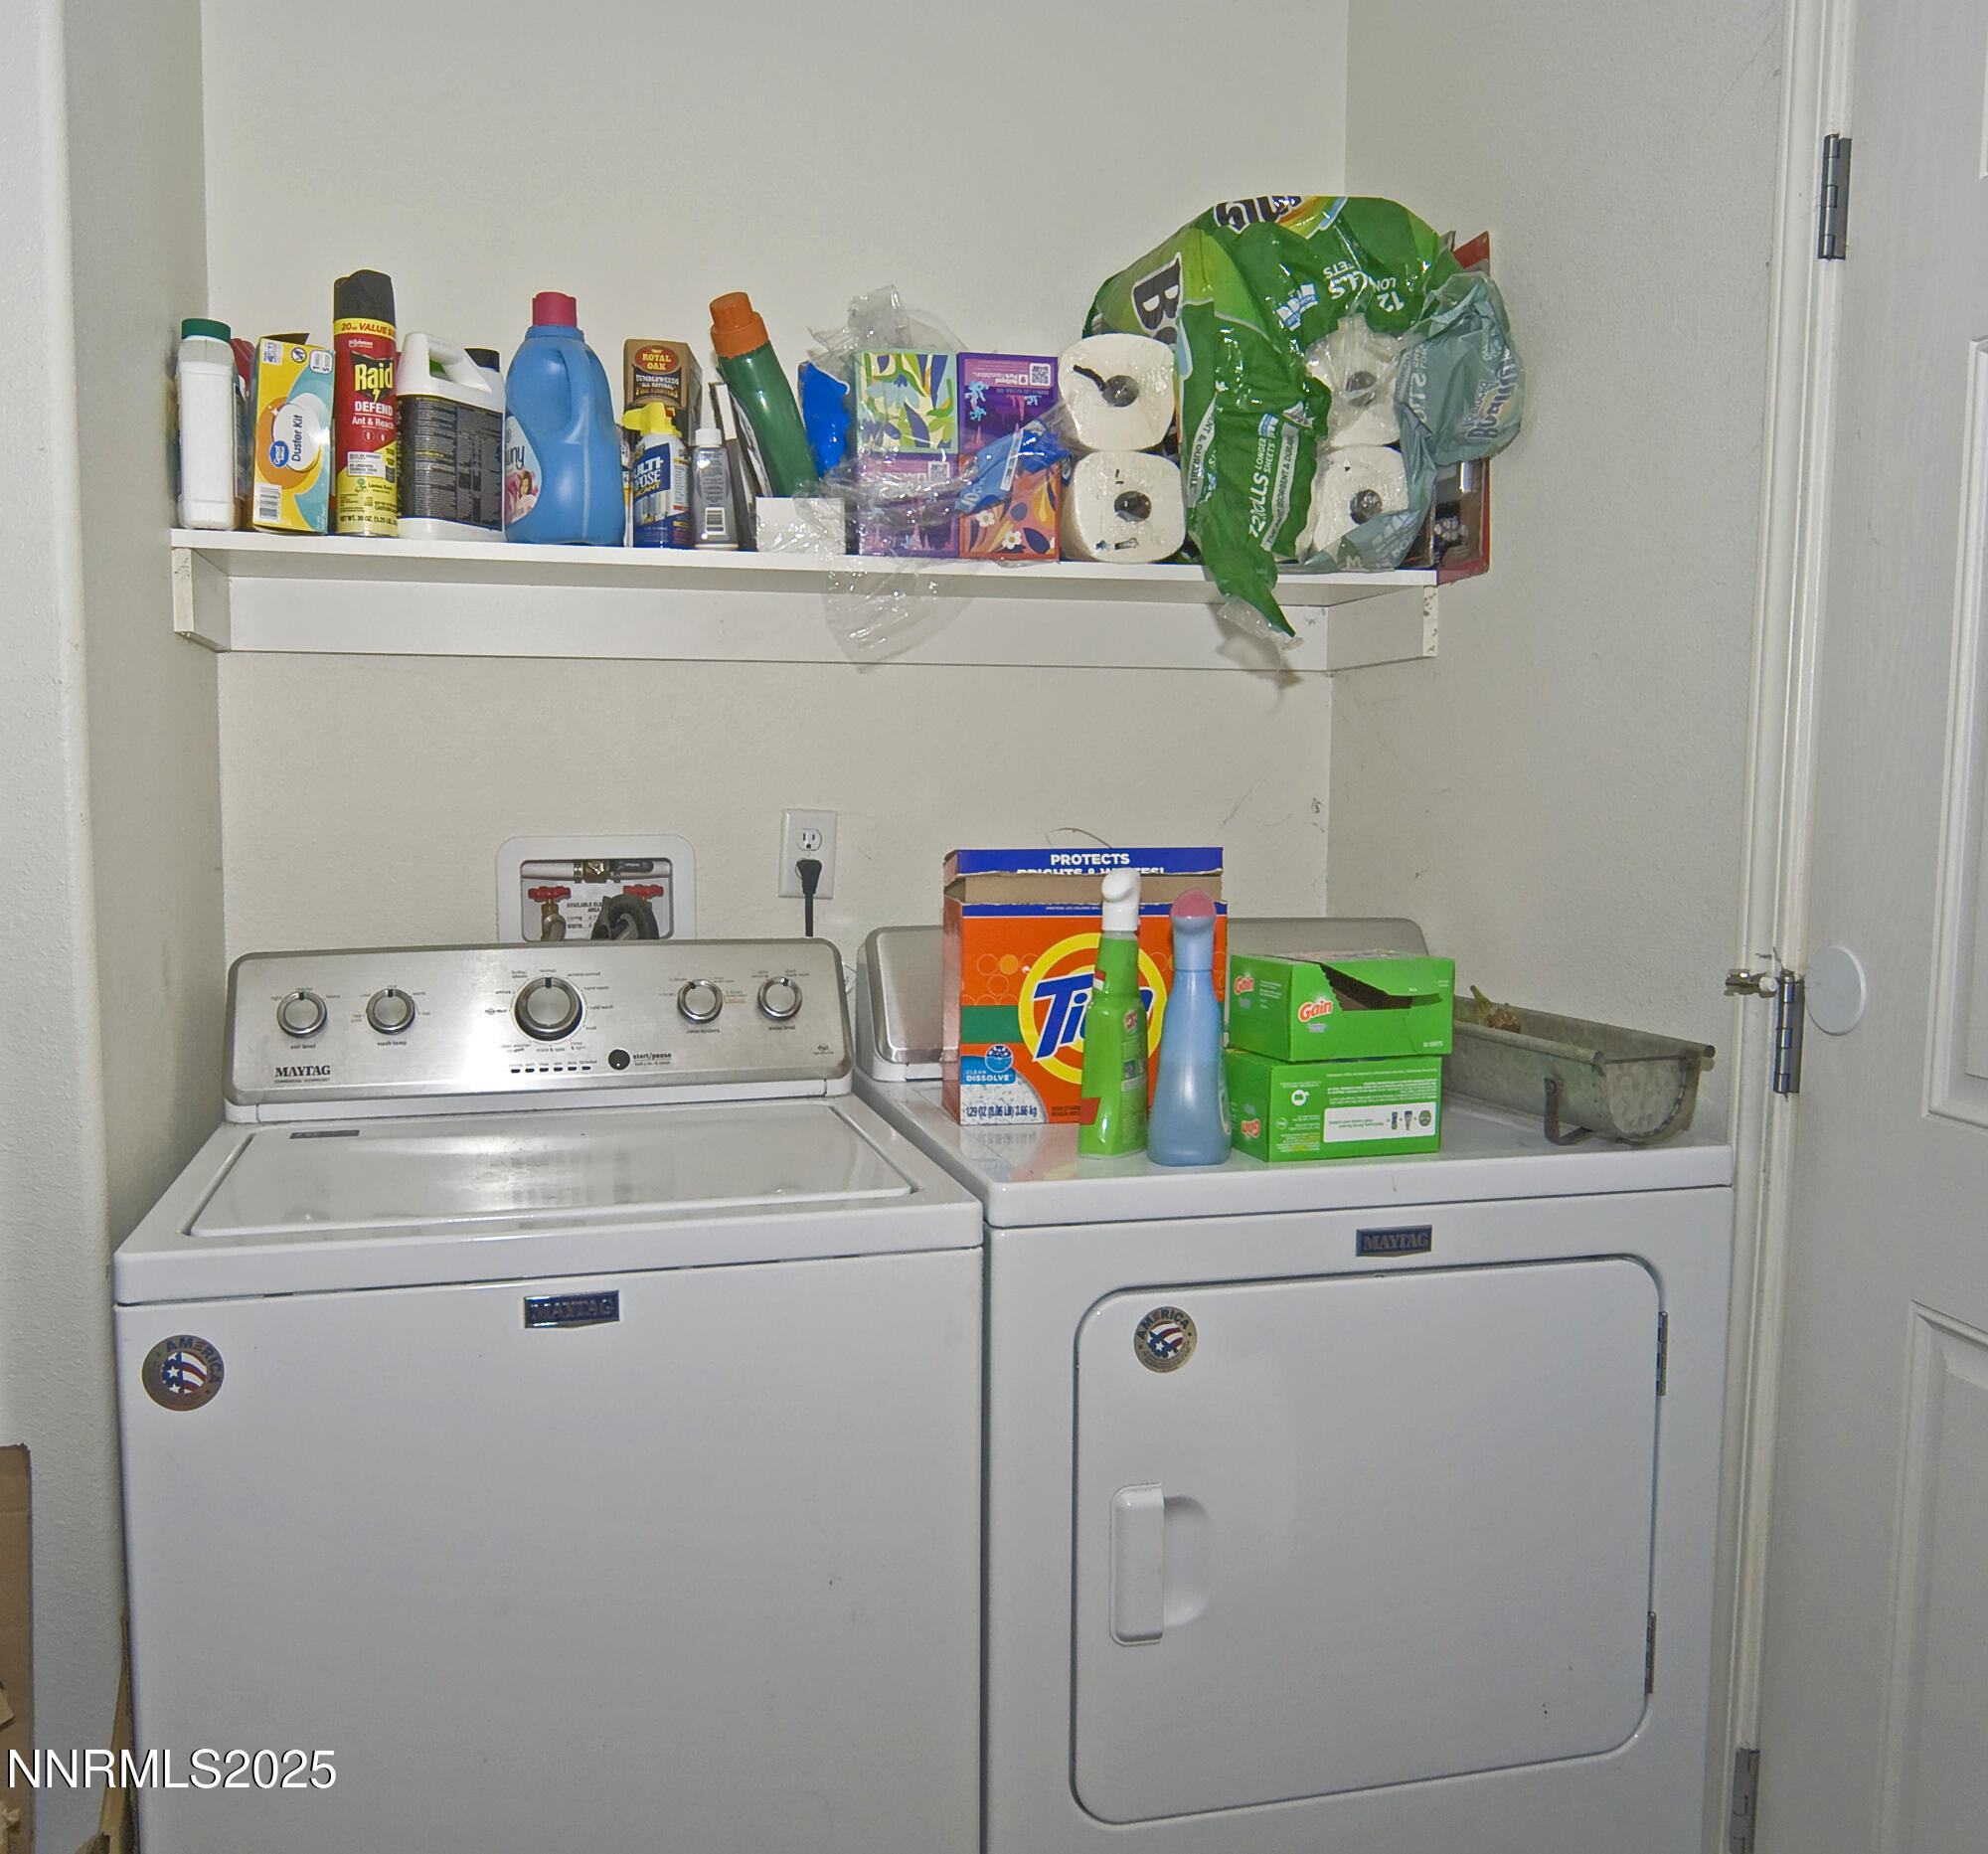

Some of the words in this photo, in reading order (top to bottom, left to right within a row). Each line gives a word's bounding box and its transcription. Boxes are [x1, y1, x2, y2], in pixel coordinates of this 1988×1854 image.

[1377, 291, 1405, 312] 12
[341, 322, 352, 331] 20
[359, 322, 388, 334] VALUE
[355, 362, 394, 392] Raid
[354, 401, 394, 416] DEFEND
[292, 415, 303, 427] Kit
[352, 417, 366, 425] Ant
[376, 419, 395, 429] Roach
[292, 427, 303, 461] Duster
[1256, 437, 1267, 470] LONGER
[634, 456, 664, 479] ULTI-
[1263, 441, 1275, 473] SHEETS
[1050, 853, 1130, 866] PROTECTS
[1234, 976, 1255, 994] Gain
[1032, 971, 1155, 1062] Ti
[1298, 999, 1333, 1022] Gain
[633, 1052, 672, 1061] start/pause
[274, 1065, 331, 1078] MAYTAG
[1030, 1105, 1038, 1117] kg
[1363, 1232, 1429, 1252] MAYTAG
[531, 1298, 613, 1321] MAYTAG
[1136, 1309, 1190, 1340] AMERICA
[166, 1336, 222, 1384] AMERICA
